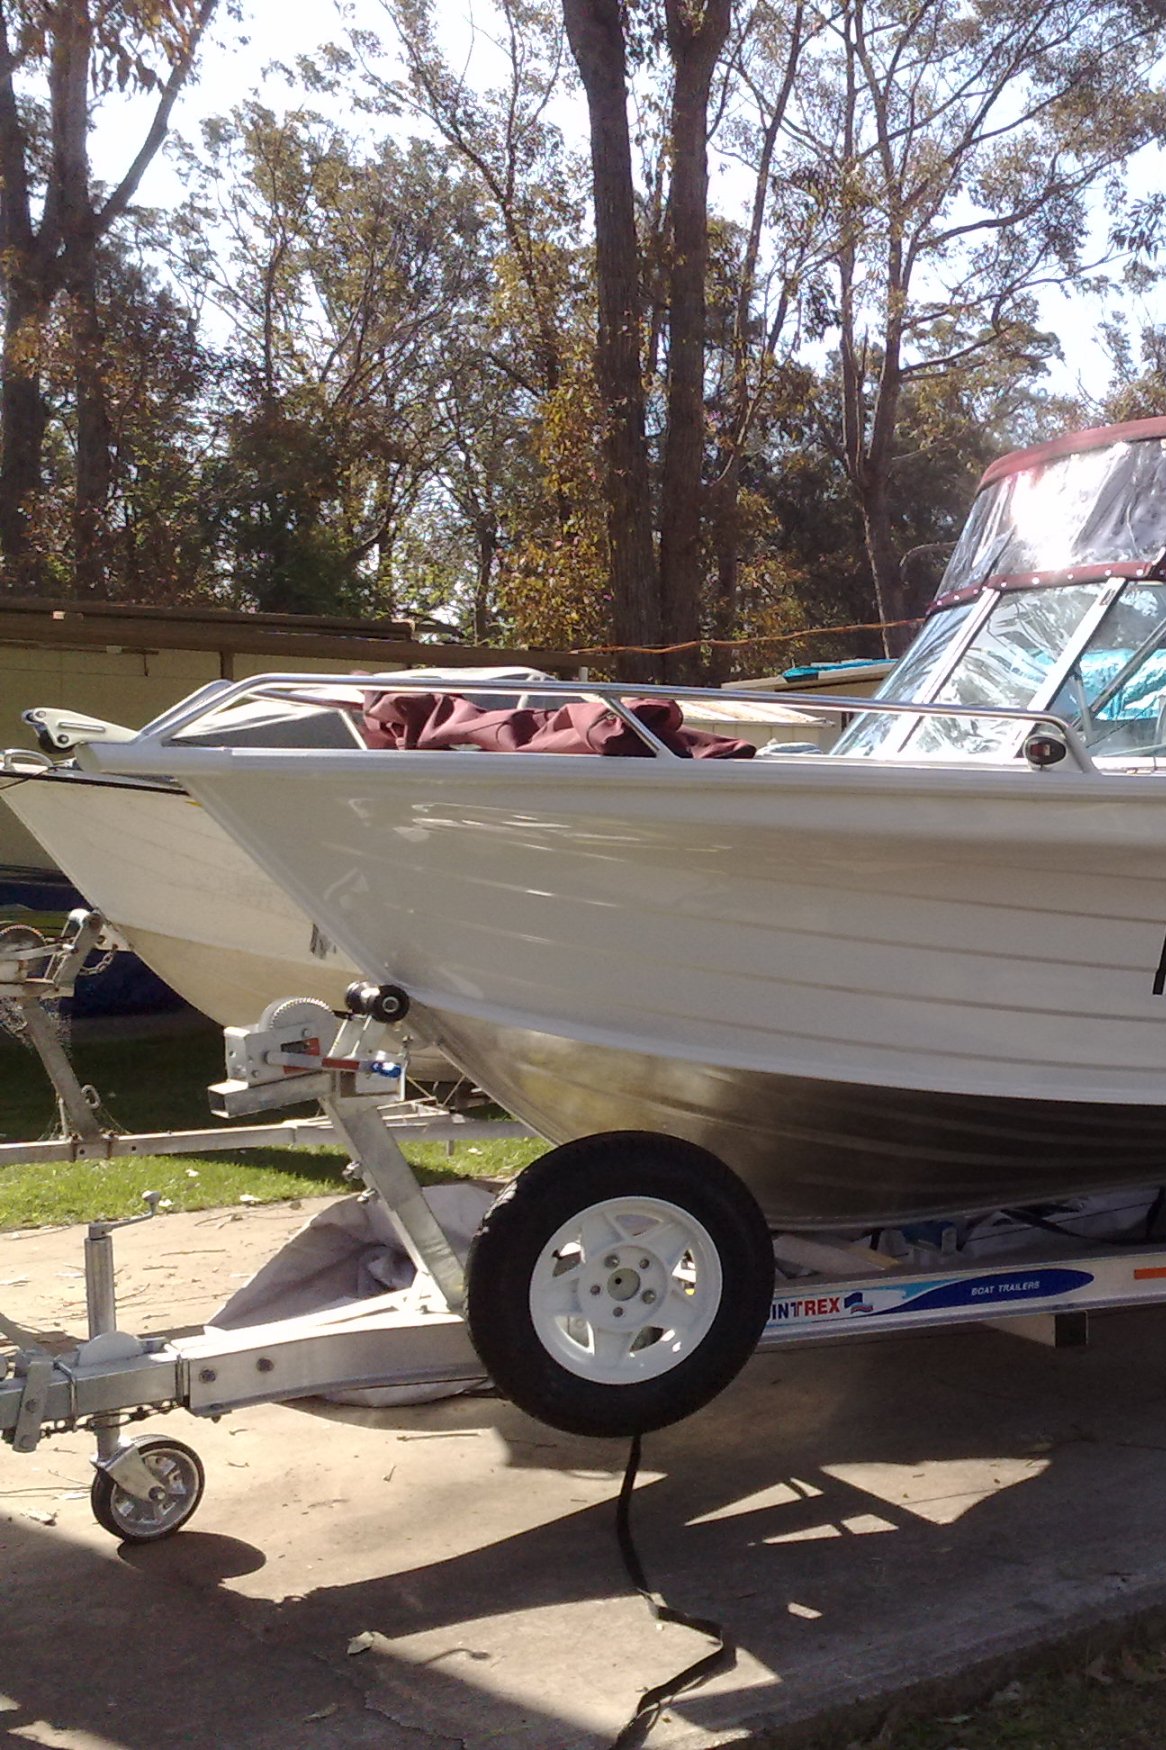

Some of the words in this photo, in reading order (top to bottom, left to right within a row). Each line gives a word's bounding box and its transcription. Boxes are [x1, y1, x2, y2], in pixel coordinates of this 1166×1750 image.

[971, 1286, 995, 1296] BOAT
[998, 1281, 1040, 1293] TRAILERS
[771, 1297, 841, 1320] INTREX
